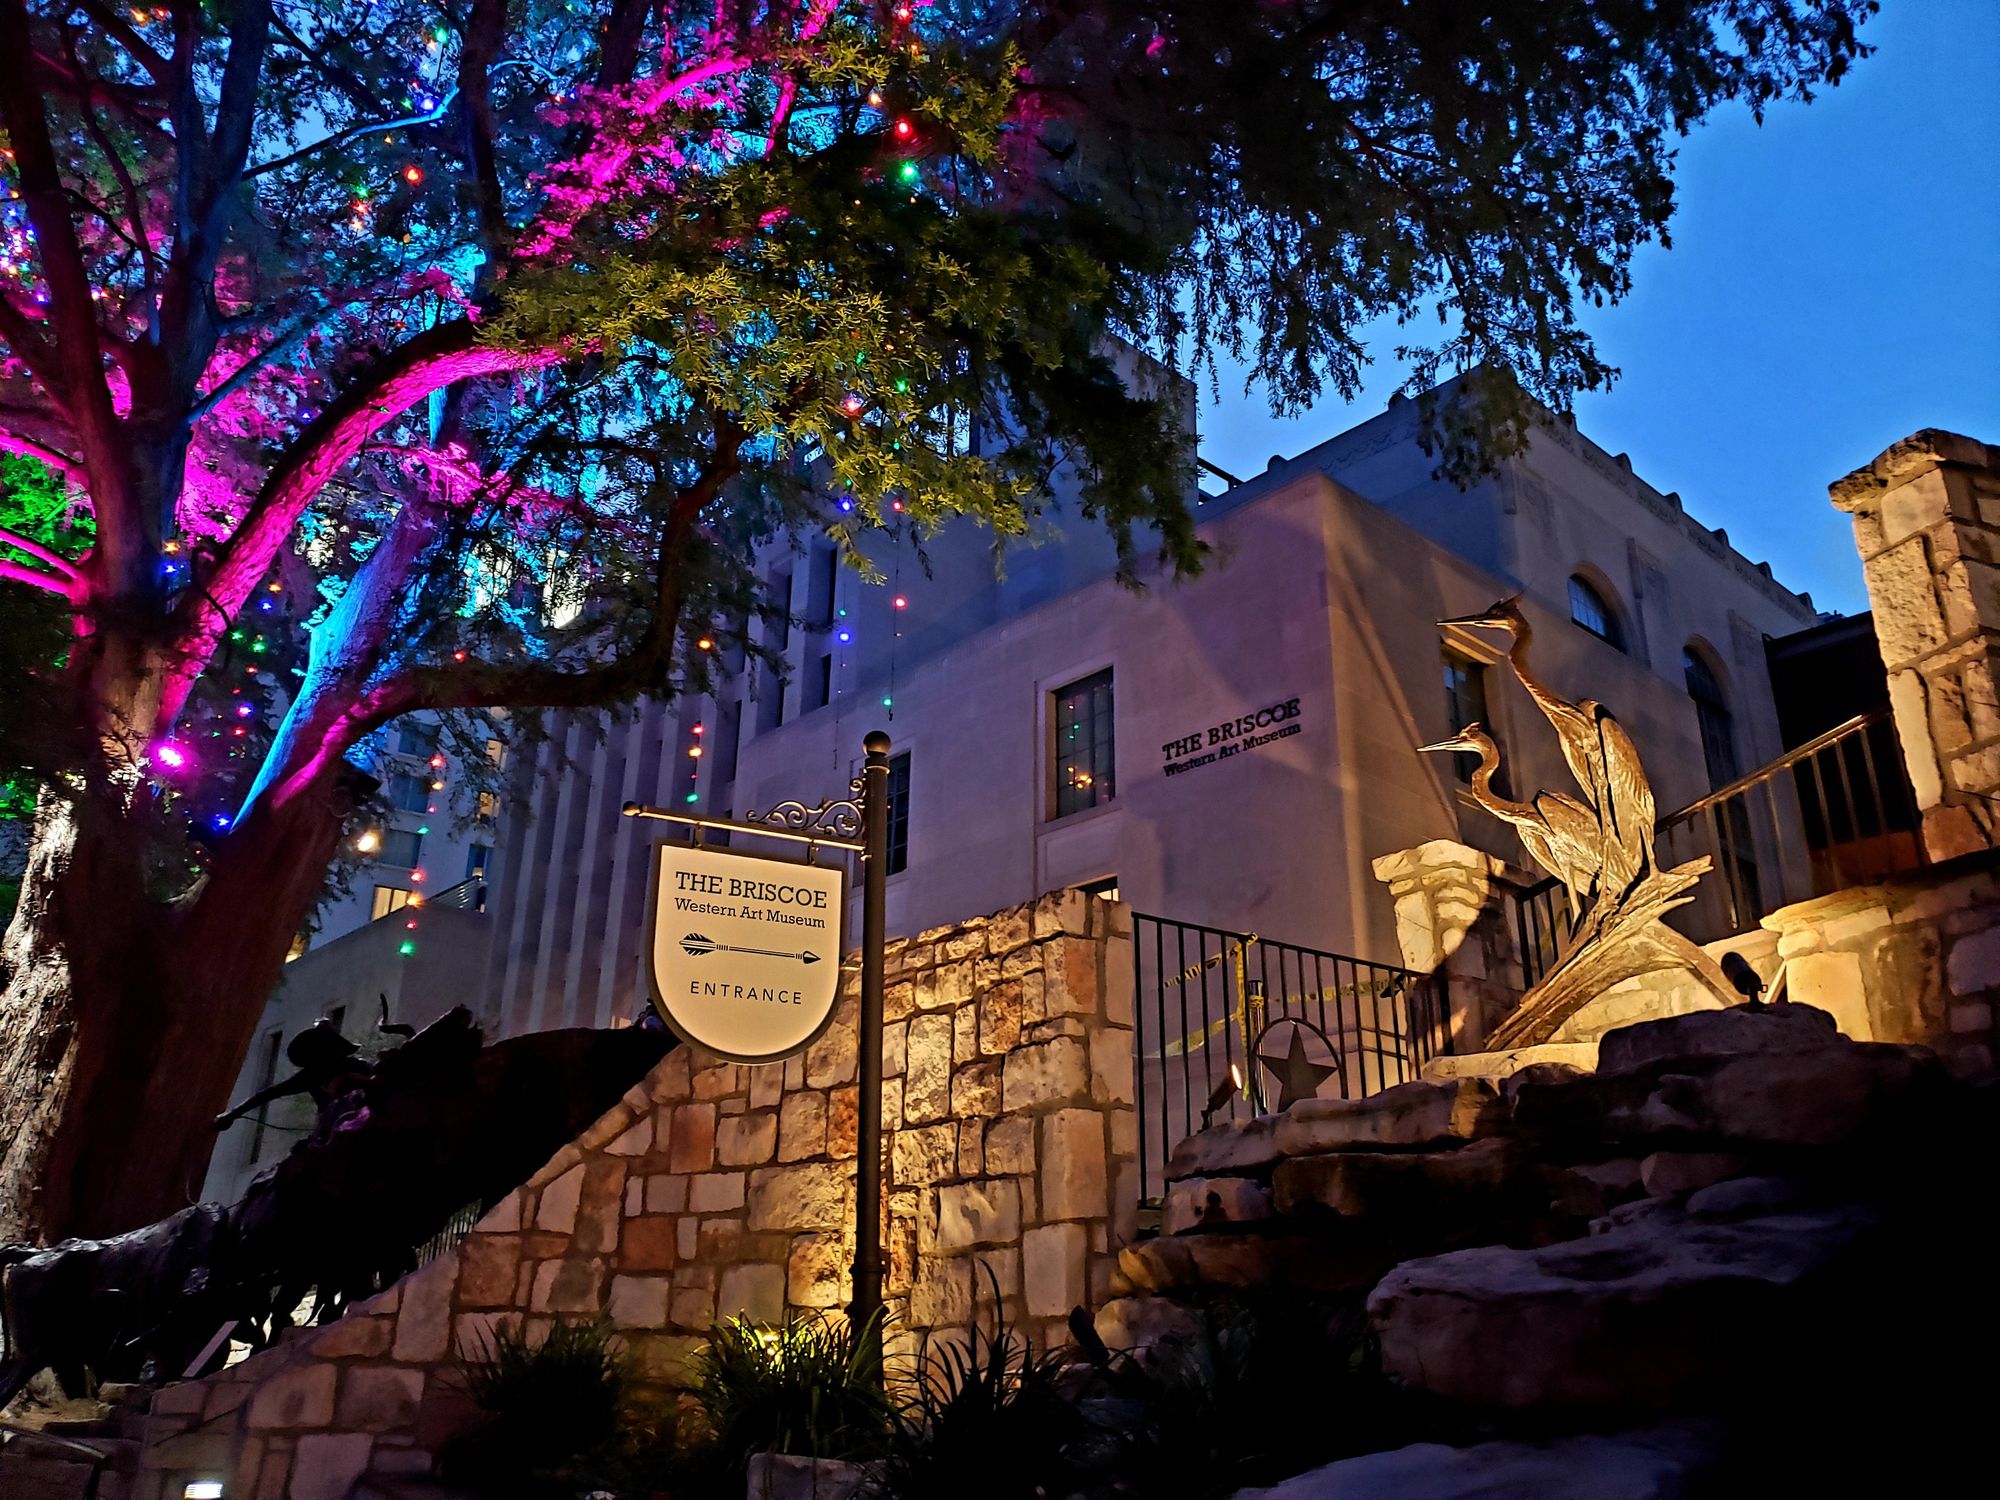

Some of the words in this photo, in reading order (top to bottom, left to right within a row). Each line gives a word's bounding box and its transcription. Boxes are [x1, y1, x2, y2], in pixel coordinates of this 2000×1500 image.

[1162, 733, 1202, 761] THE
[1207, 698, 1301, 746] BRISCOE
[1163, 753, 1216, 777] Western
[1219, 743, 1240, 760] Art
[1242, 723, 1301, 752] Museum
[675, 871, 723, 894] THE
[728, 878, 827, 909] BRISCOE
[674, 897, 736, 917] Western
[740, 906, 763, 920] Art
[766, 909, 826, 929] Museum
[690, 981, 802, 1005] ENTRANCE
